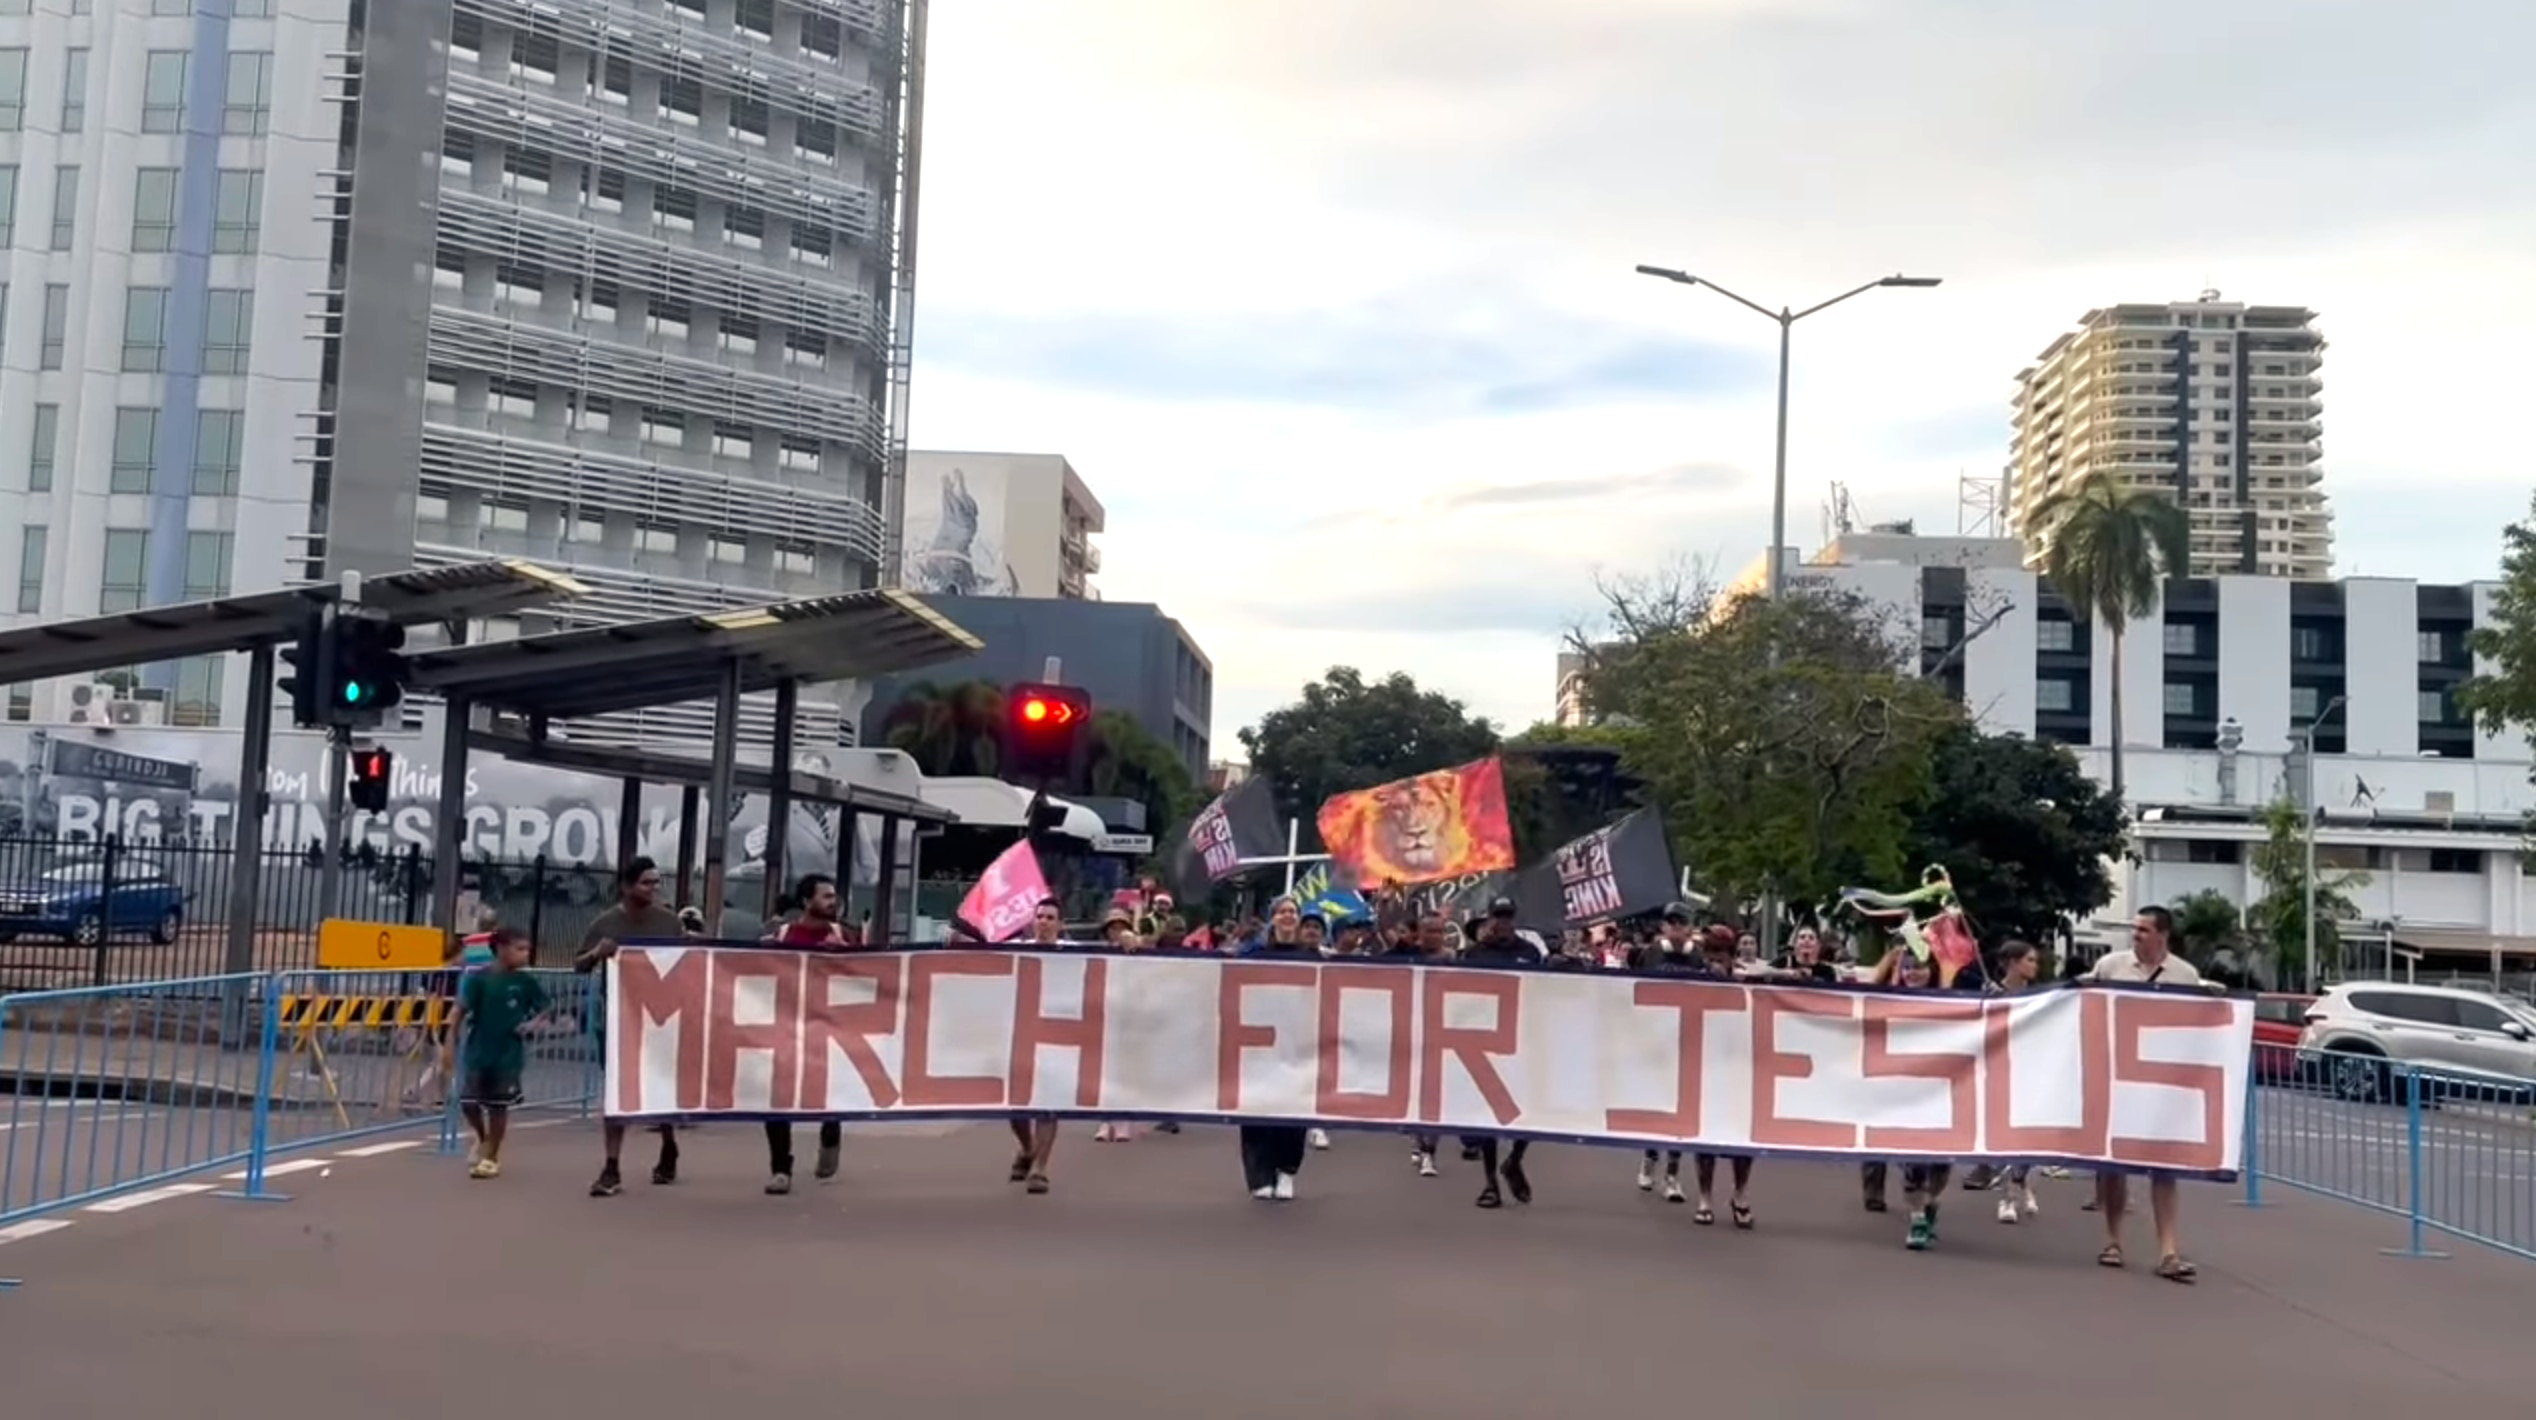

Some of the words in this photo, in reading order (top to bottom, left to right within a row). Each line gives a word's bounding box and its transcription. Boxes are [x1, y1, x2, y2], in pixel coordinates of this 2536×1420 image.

[390, 755, 479, 799] thins
[55, 794, 163, 859] BIG
[617, 950, 1108, 1111] MARCH
[1217, 962, 1523, 1126] FOR
[1606, 979, 2234, 1169] JESUS
